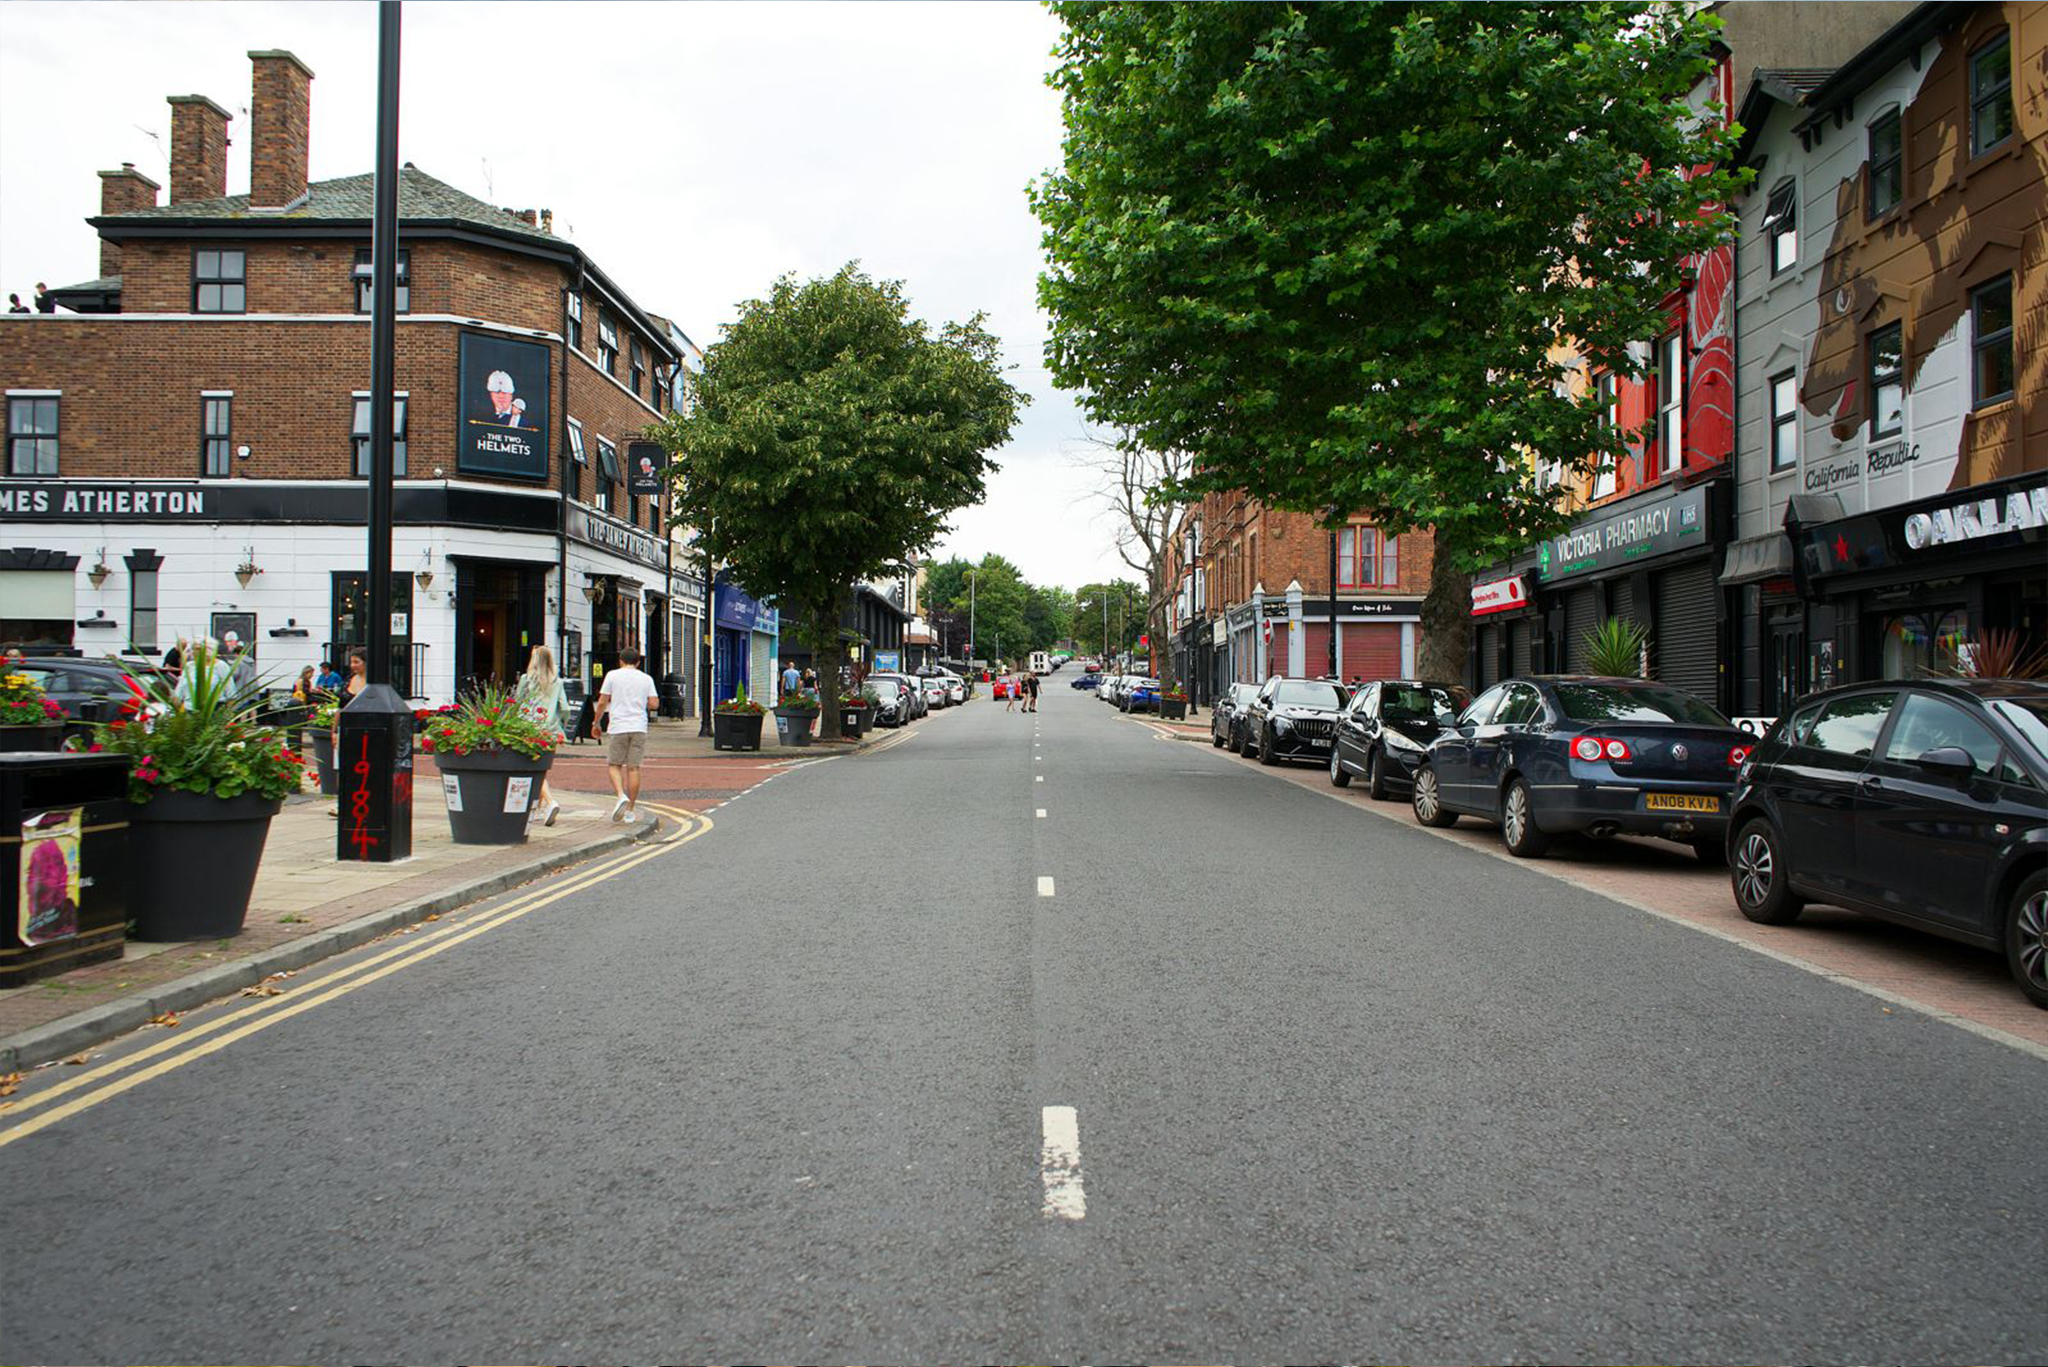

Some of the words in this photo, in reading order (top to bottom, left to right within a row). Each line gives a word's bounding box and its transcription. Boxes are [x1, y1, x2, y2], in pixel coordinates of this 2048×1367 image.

[476, 439, 531, 456] HELMETS
[487, 432, 502, 442] THE
[504, 435, 521, 444] TWO
[1805, 460, 1860, 492] California
[1866, 441, 1920, 476] Republic
[62, 490, 204, 514] ATHERTON
[1557, 529, 1602, 563] VICTORIA
[1605, 506, 1671, 550] PHARMACY
[1651, 794, 1686, 809] AN08
[1687, 796, 1713, 811] KVA
